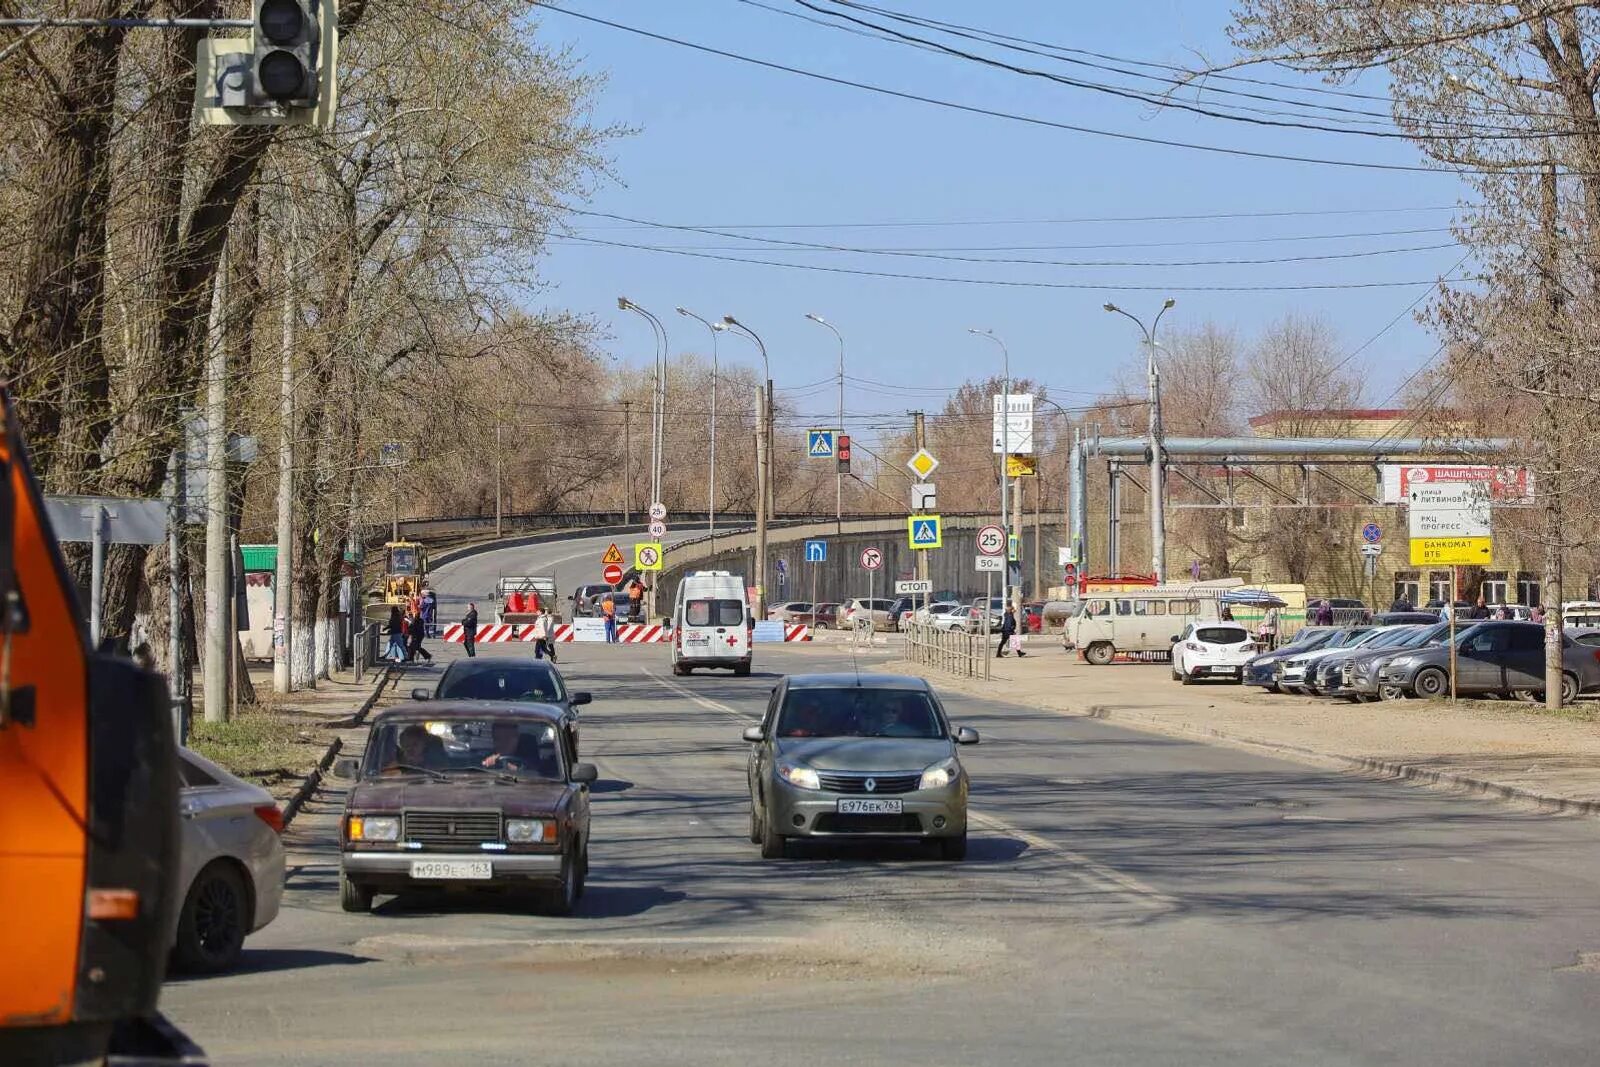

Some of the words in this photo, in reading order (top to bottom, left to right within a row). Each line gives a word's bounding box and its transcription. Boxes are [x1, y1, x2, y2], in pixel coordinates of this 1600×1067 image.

[1424, 550, 1440, 558] ВТБ
[980, 559, 993, 568] 50
[900, 583, 928, 591] СТОП
